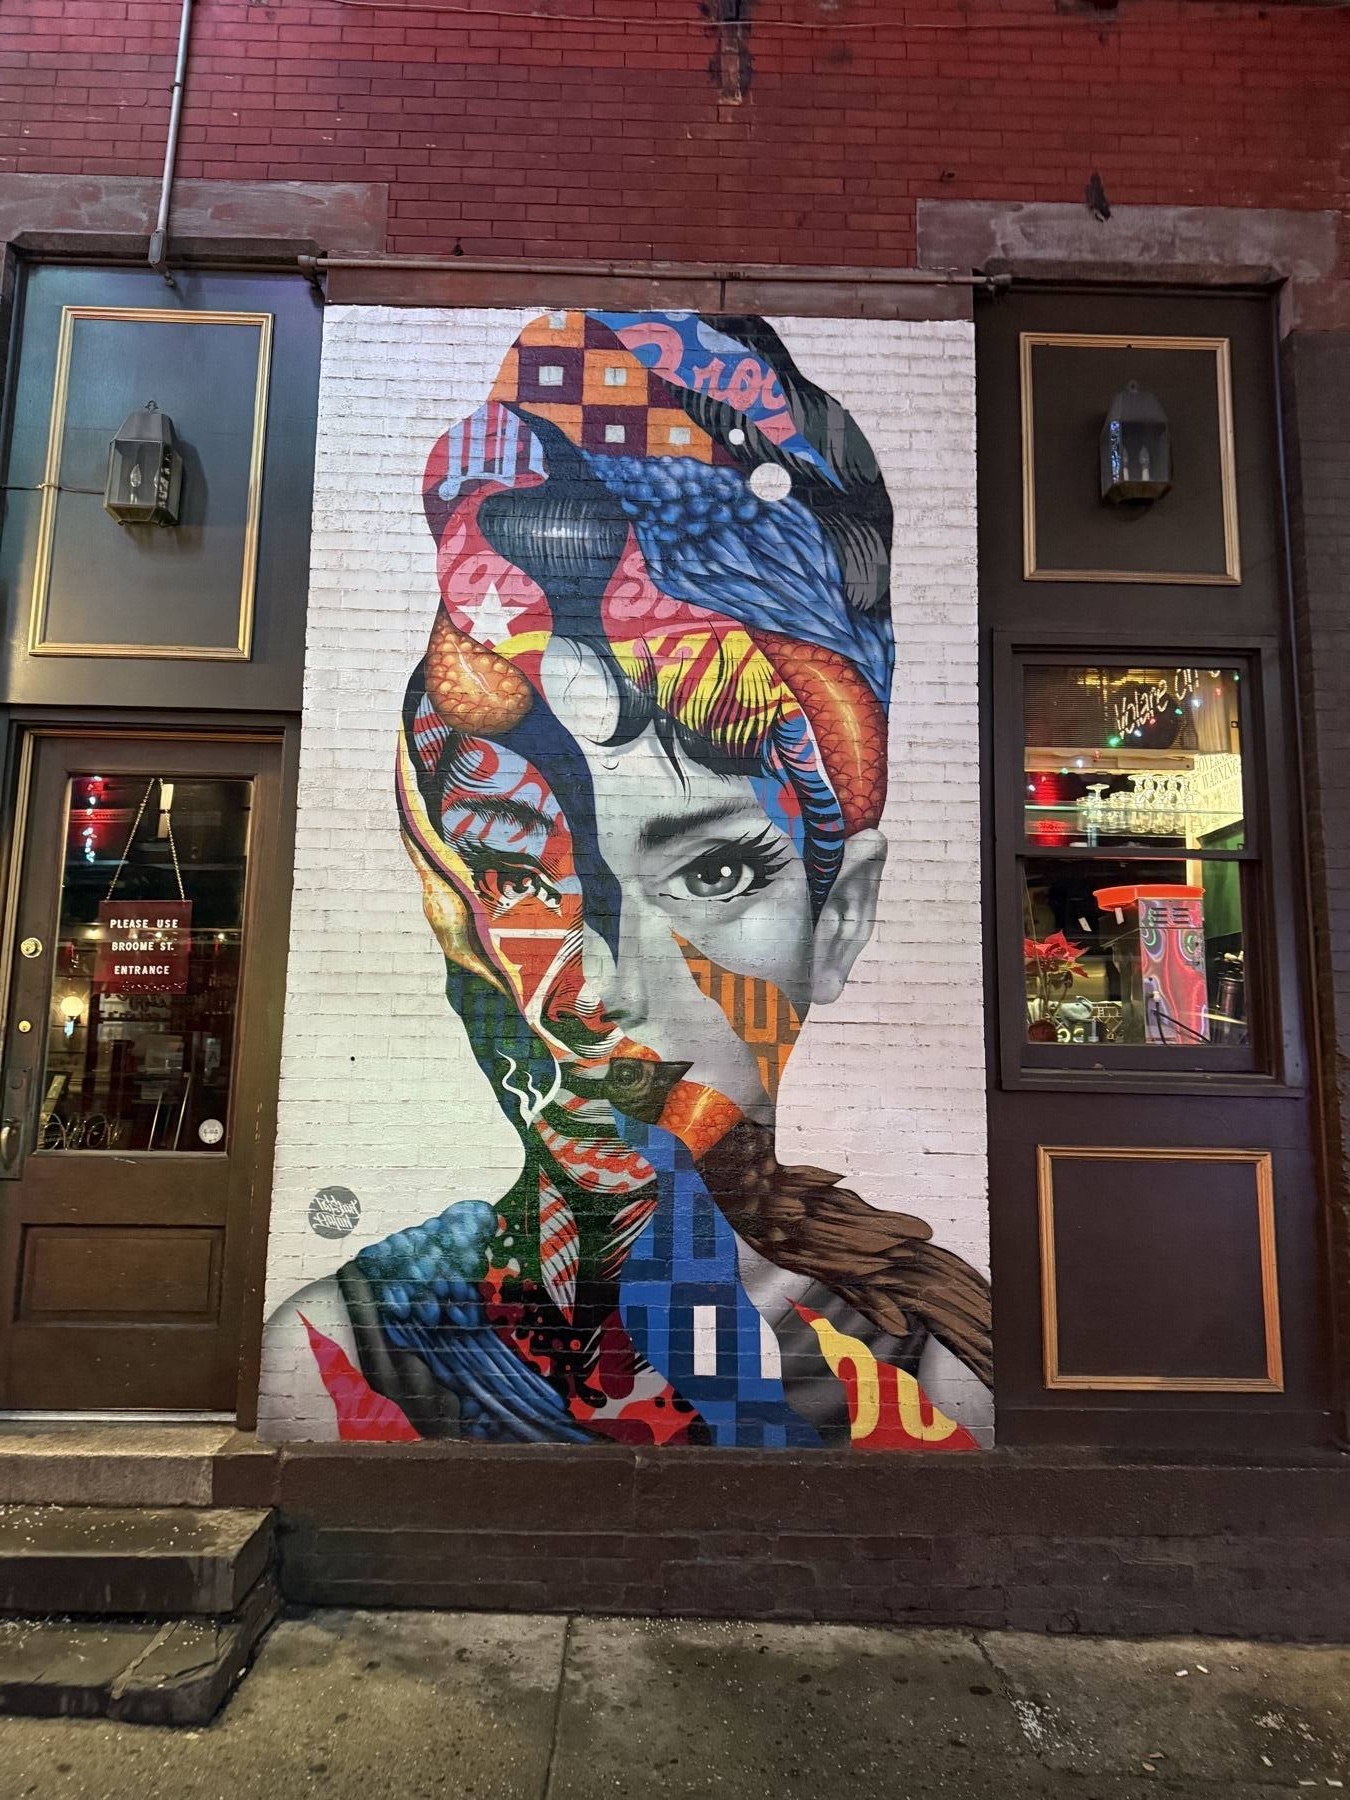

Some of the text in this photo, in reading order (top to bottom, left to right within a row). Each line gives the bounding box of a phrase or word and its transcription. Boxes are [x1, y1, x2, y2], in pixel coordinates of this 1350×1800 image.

[110, 919, 179, 929] PLEASE USE
[111, 941, 175, 951] BROOME ST.
[114, 965, 170, 975] ENTRANCE
